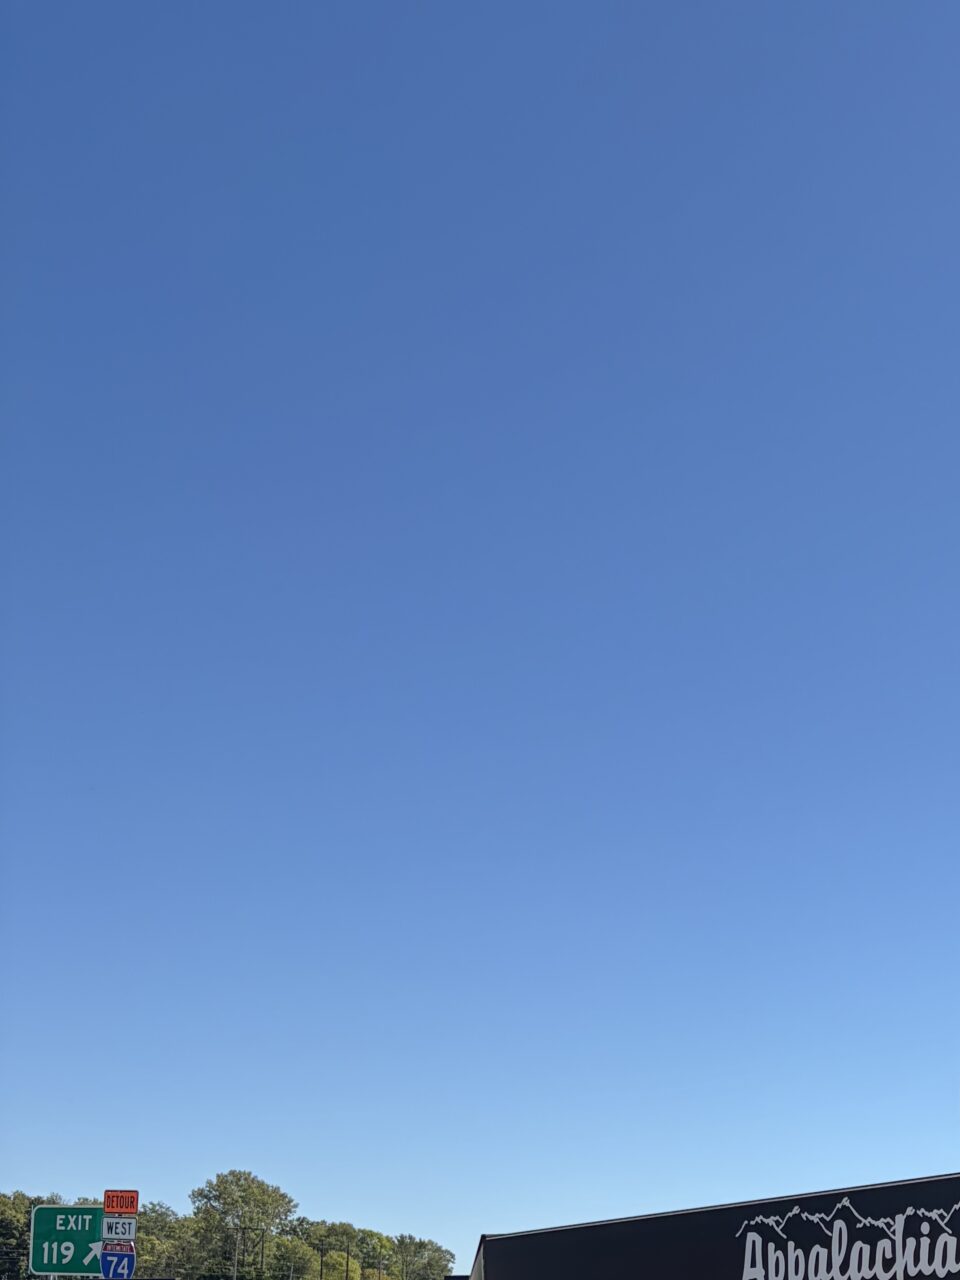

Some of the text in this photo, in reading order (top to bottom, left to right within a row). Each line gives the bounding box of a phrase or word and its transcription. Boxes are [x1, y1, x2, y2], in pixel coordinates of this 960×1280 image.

[106, 1196, 135, 1209] DETOUR
[56, 1215, 92, 1230] EXIT
[107, 1222, 132, 1235] WEST
[42, 1241, 75, 1264] 119
[106, 1256, 129, 1279] 74
